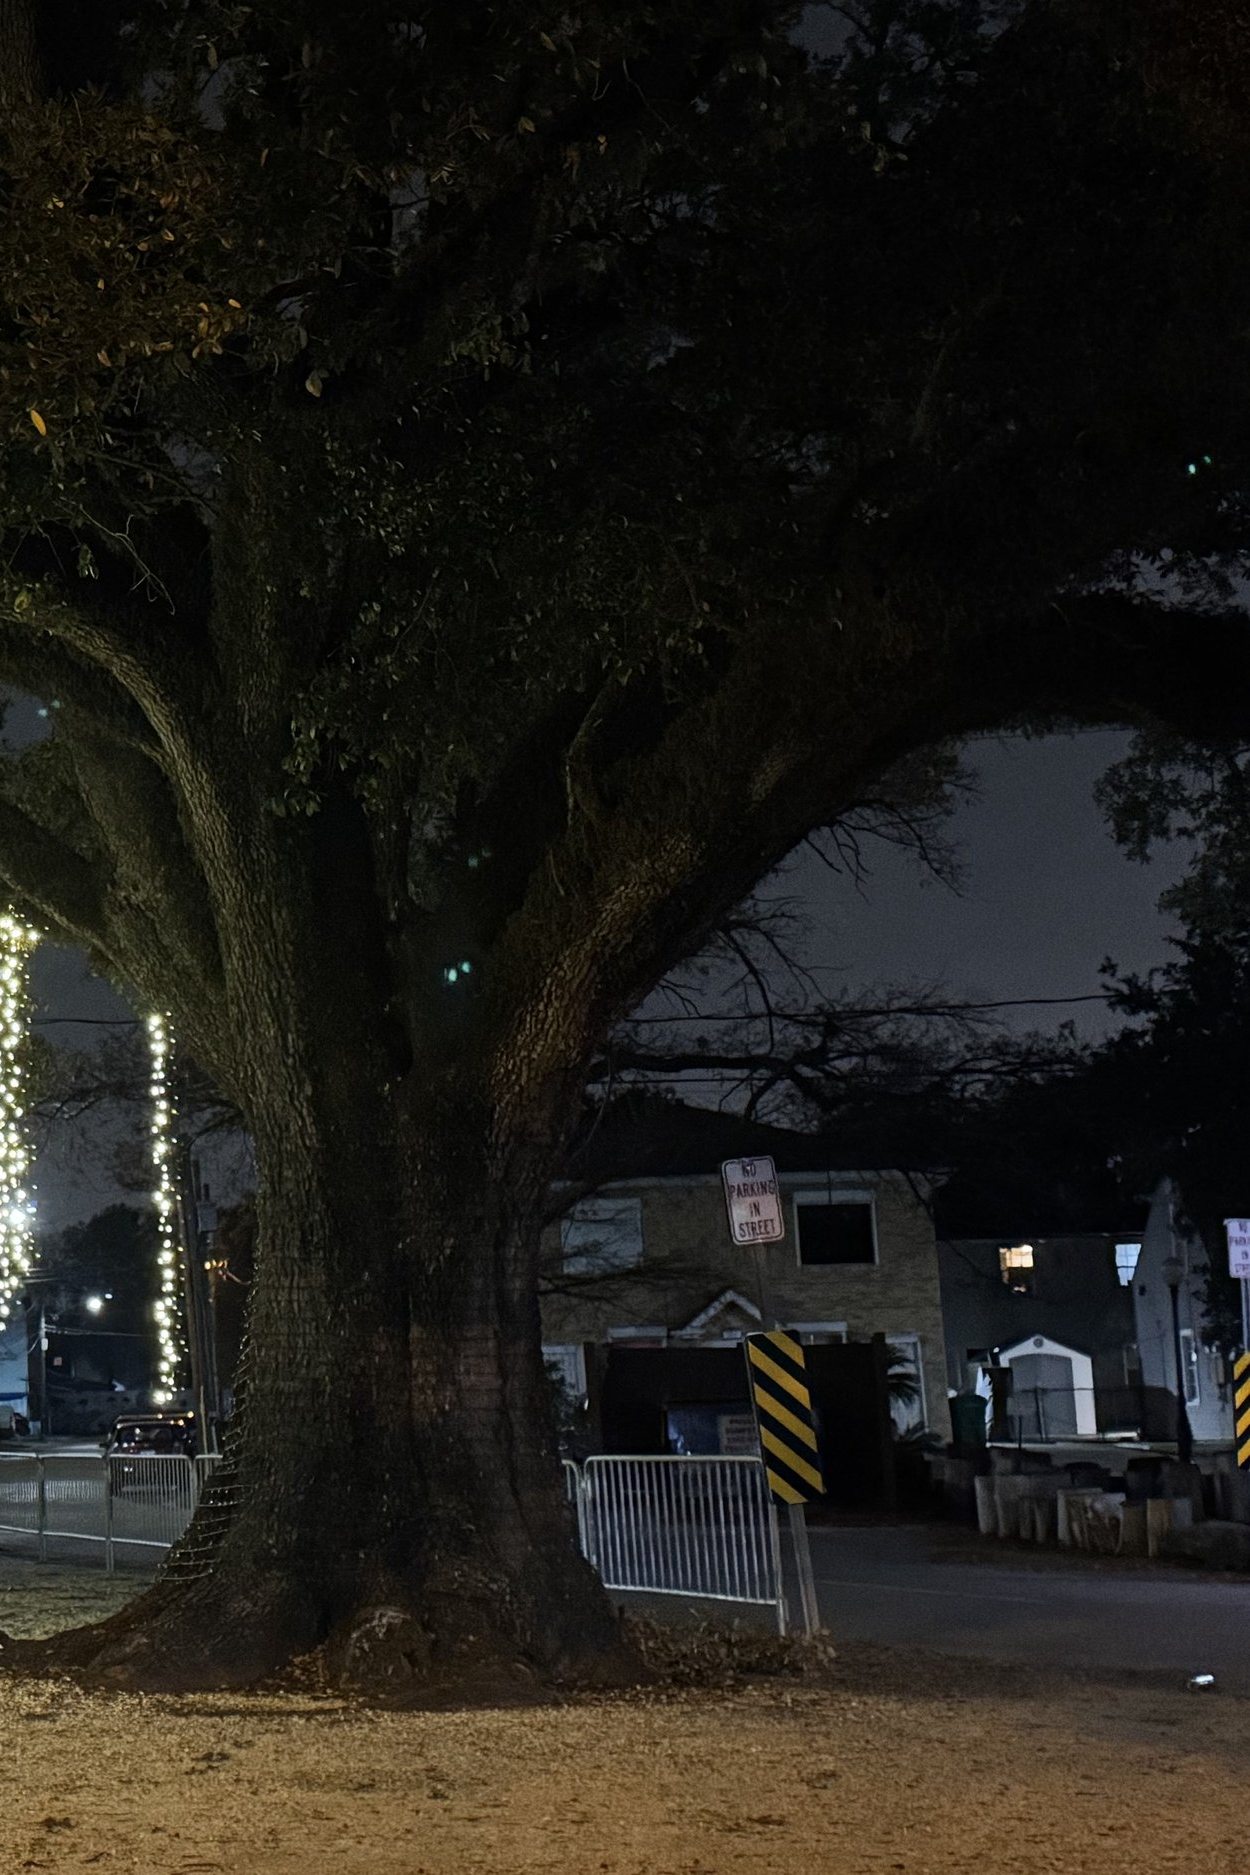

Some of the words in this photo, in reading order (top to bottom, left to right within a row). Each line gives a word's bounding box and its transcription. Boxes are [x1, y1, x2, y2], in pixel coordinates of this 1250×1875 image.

[741, 1162, 757, 1178] NO
[728, 1180, 776, 1200] PARKING
[749, 1201, 761, 1218] IN
[738, 1219, 776, 1238] STREET
